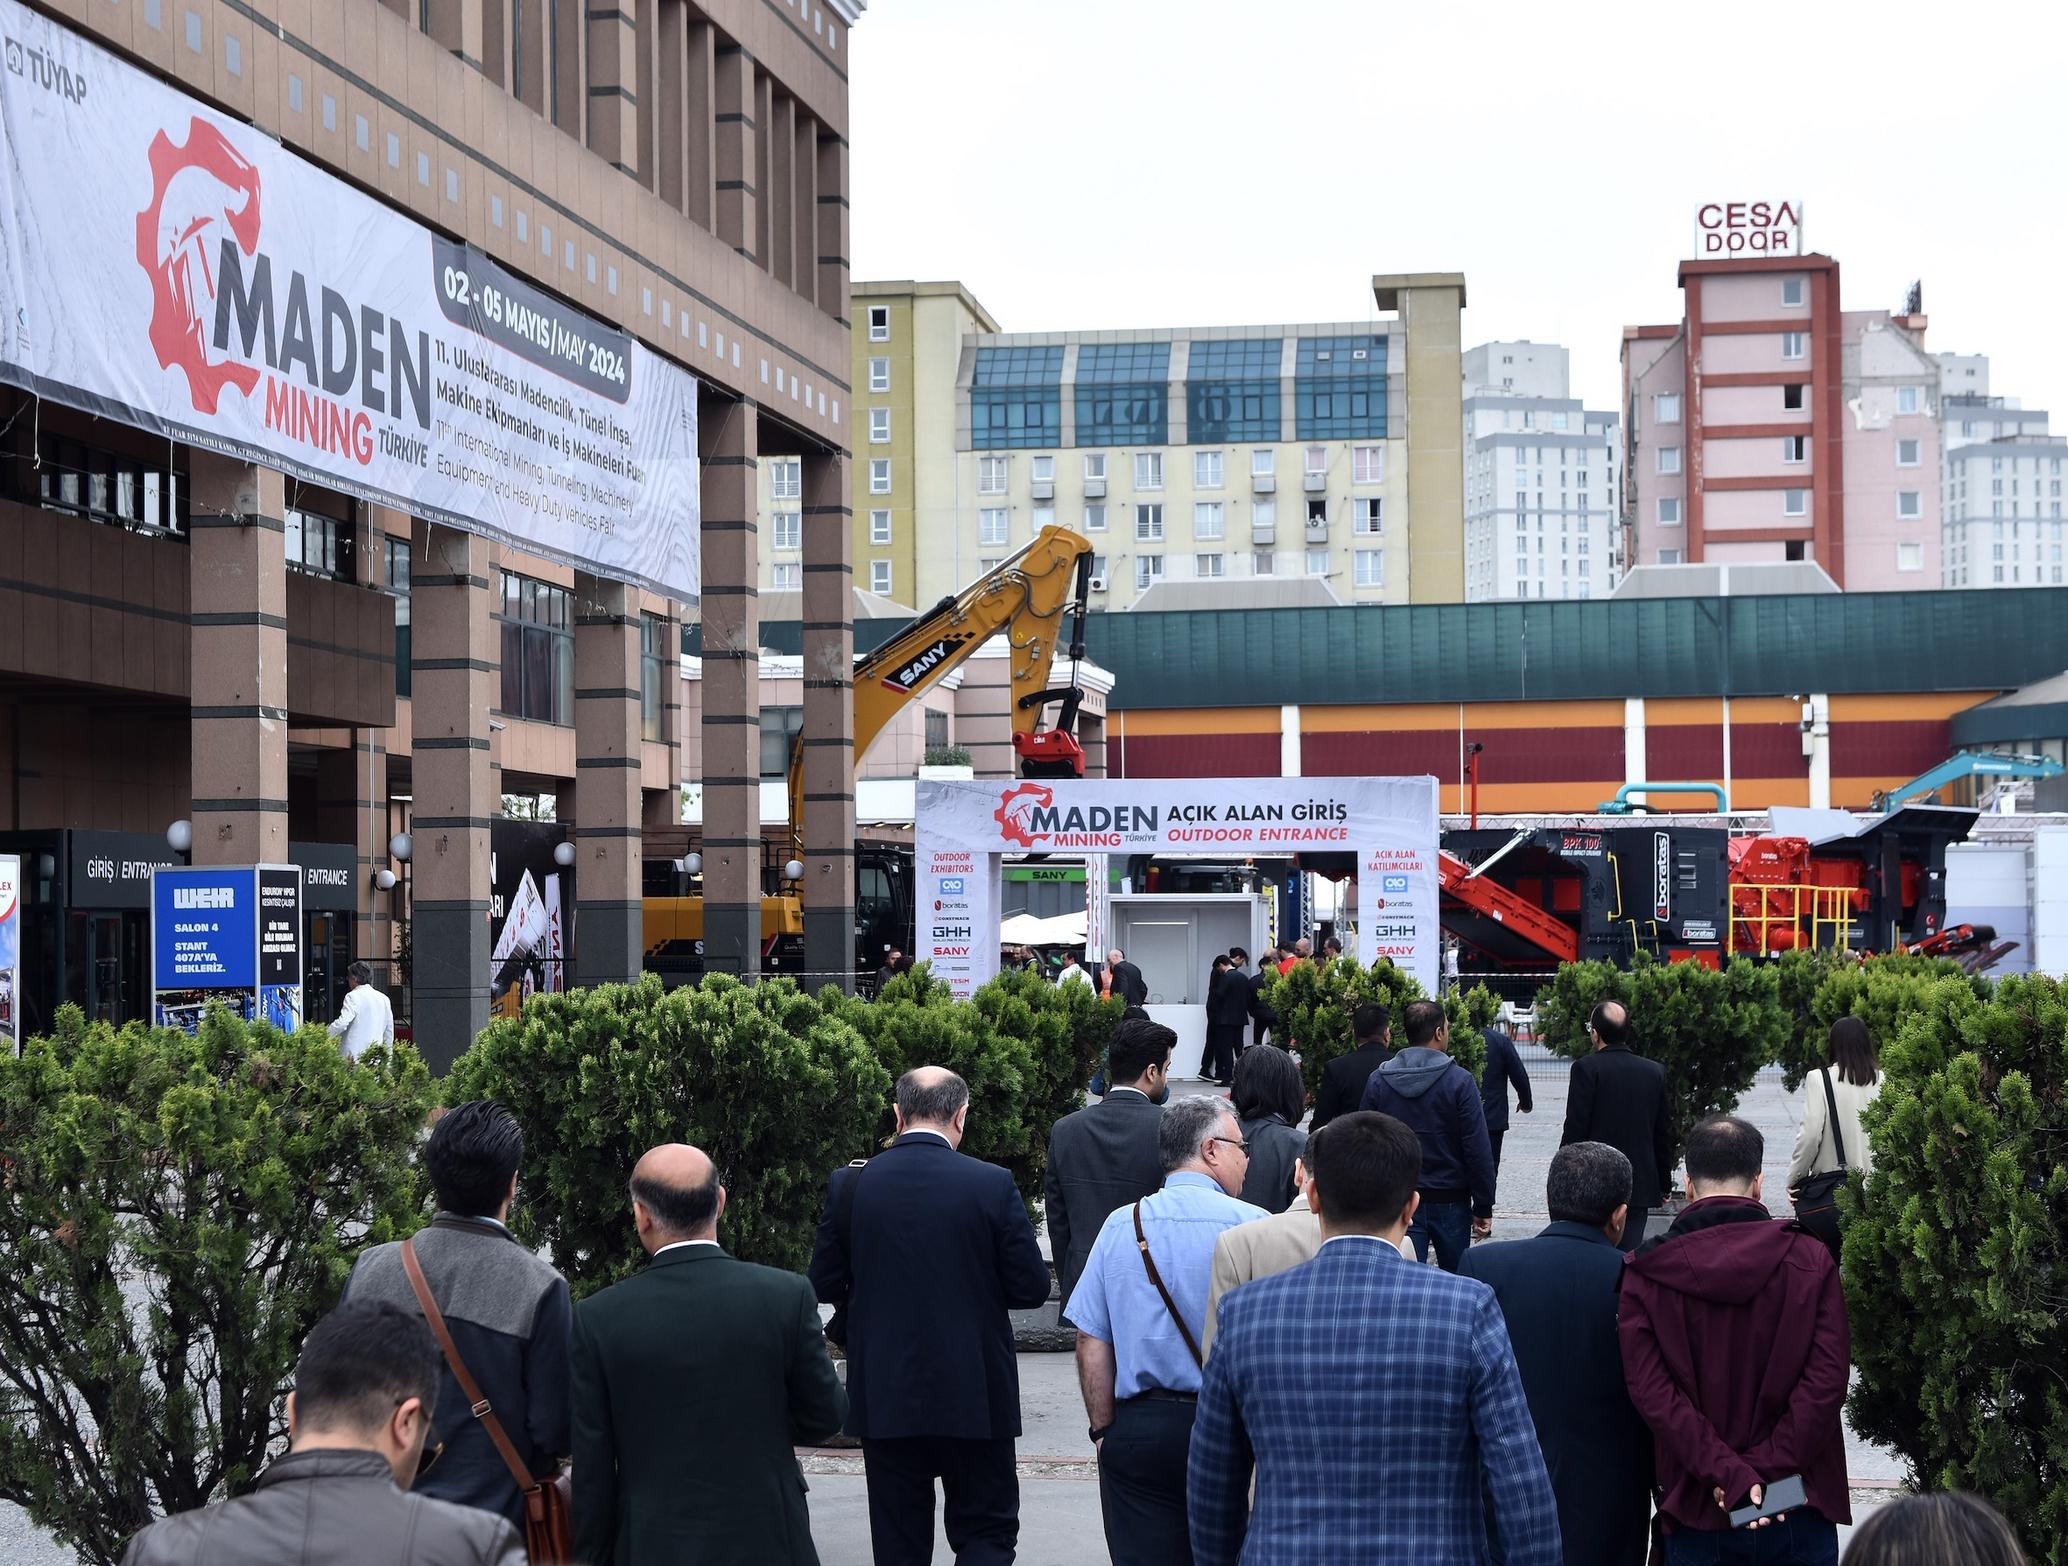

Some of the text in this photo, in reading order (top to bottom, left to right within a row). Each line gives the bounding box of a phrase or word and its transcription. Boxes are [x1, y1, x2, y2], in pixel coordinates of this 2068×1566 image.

[27, 45, 87, 105] TÜYAP
[1698, 201, 1798, 229] CESA
[1706, 231, 1789, 252] DOOR
[213, 237, 431, 431] MADEN
[444, 265, 470, 306] 02
[483, 284, 503, 323] 05
[588, 342, 626, 385] 2024
[435, 339, 632, 451] 11. Uluslararası Madencilik, Tünel İnşa,
[264, 375, 374, 466] MINING
[437, 377, 482, 416] Makine
[485, 397, 545, 445] Ekipmanları
[547, 431, 560, 451] ve
[562, 427, 571, 461] İş
[573, 438, 625, 476] Makineleri
[378, 425, 429, 469] TÜRKİYE
[454, 425, 511, 468] International
[513, 451, 545, 487] Mining,
[591, 482, 634, 518] Machinery
[437, 453, 616, 536] Equipment and Heavy Duty Vehicles Fair
[900, 642, 946, 686] SANY
[1030, 806, 1158, 832] MADEN
[1167, 799, 1348, 826] AÇIK ALAN GİRİŞ
[1054, 833, 1157, 847] MINING TÜRKİYE
[1168, 827, 1348, 842] OUTDOOR ENTRANCE
[933, 853, 970, 862] OUTDOOR
[1375, 850, 1416, 860] AÇIK ALAN
[87, 856, 114, 883] GİRİŞ
[930, 864, 974, 873] EXHIBITORS
[1032, 871, 1067, 880] SANY
[1368, 862, 1423, 871] KATILIMCILARI
[308, 869, 348, 886] ENTRANCE
[174, 887, 234, 909] WEIR
[174, 923, 219, 933] SALON 4
[933, 926, 971, 937] GHH
[1376, 925, 1415, 936] GHH
[174, 942, 208, 951] STANT
[933, 946, 970, 955] SANY
[1377, 946, 1415, 955] SANY
[174, 953, 218, 962] 407A'YA
[175, 963, 226, 973] BEKLERİZ.
